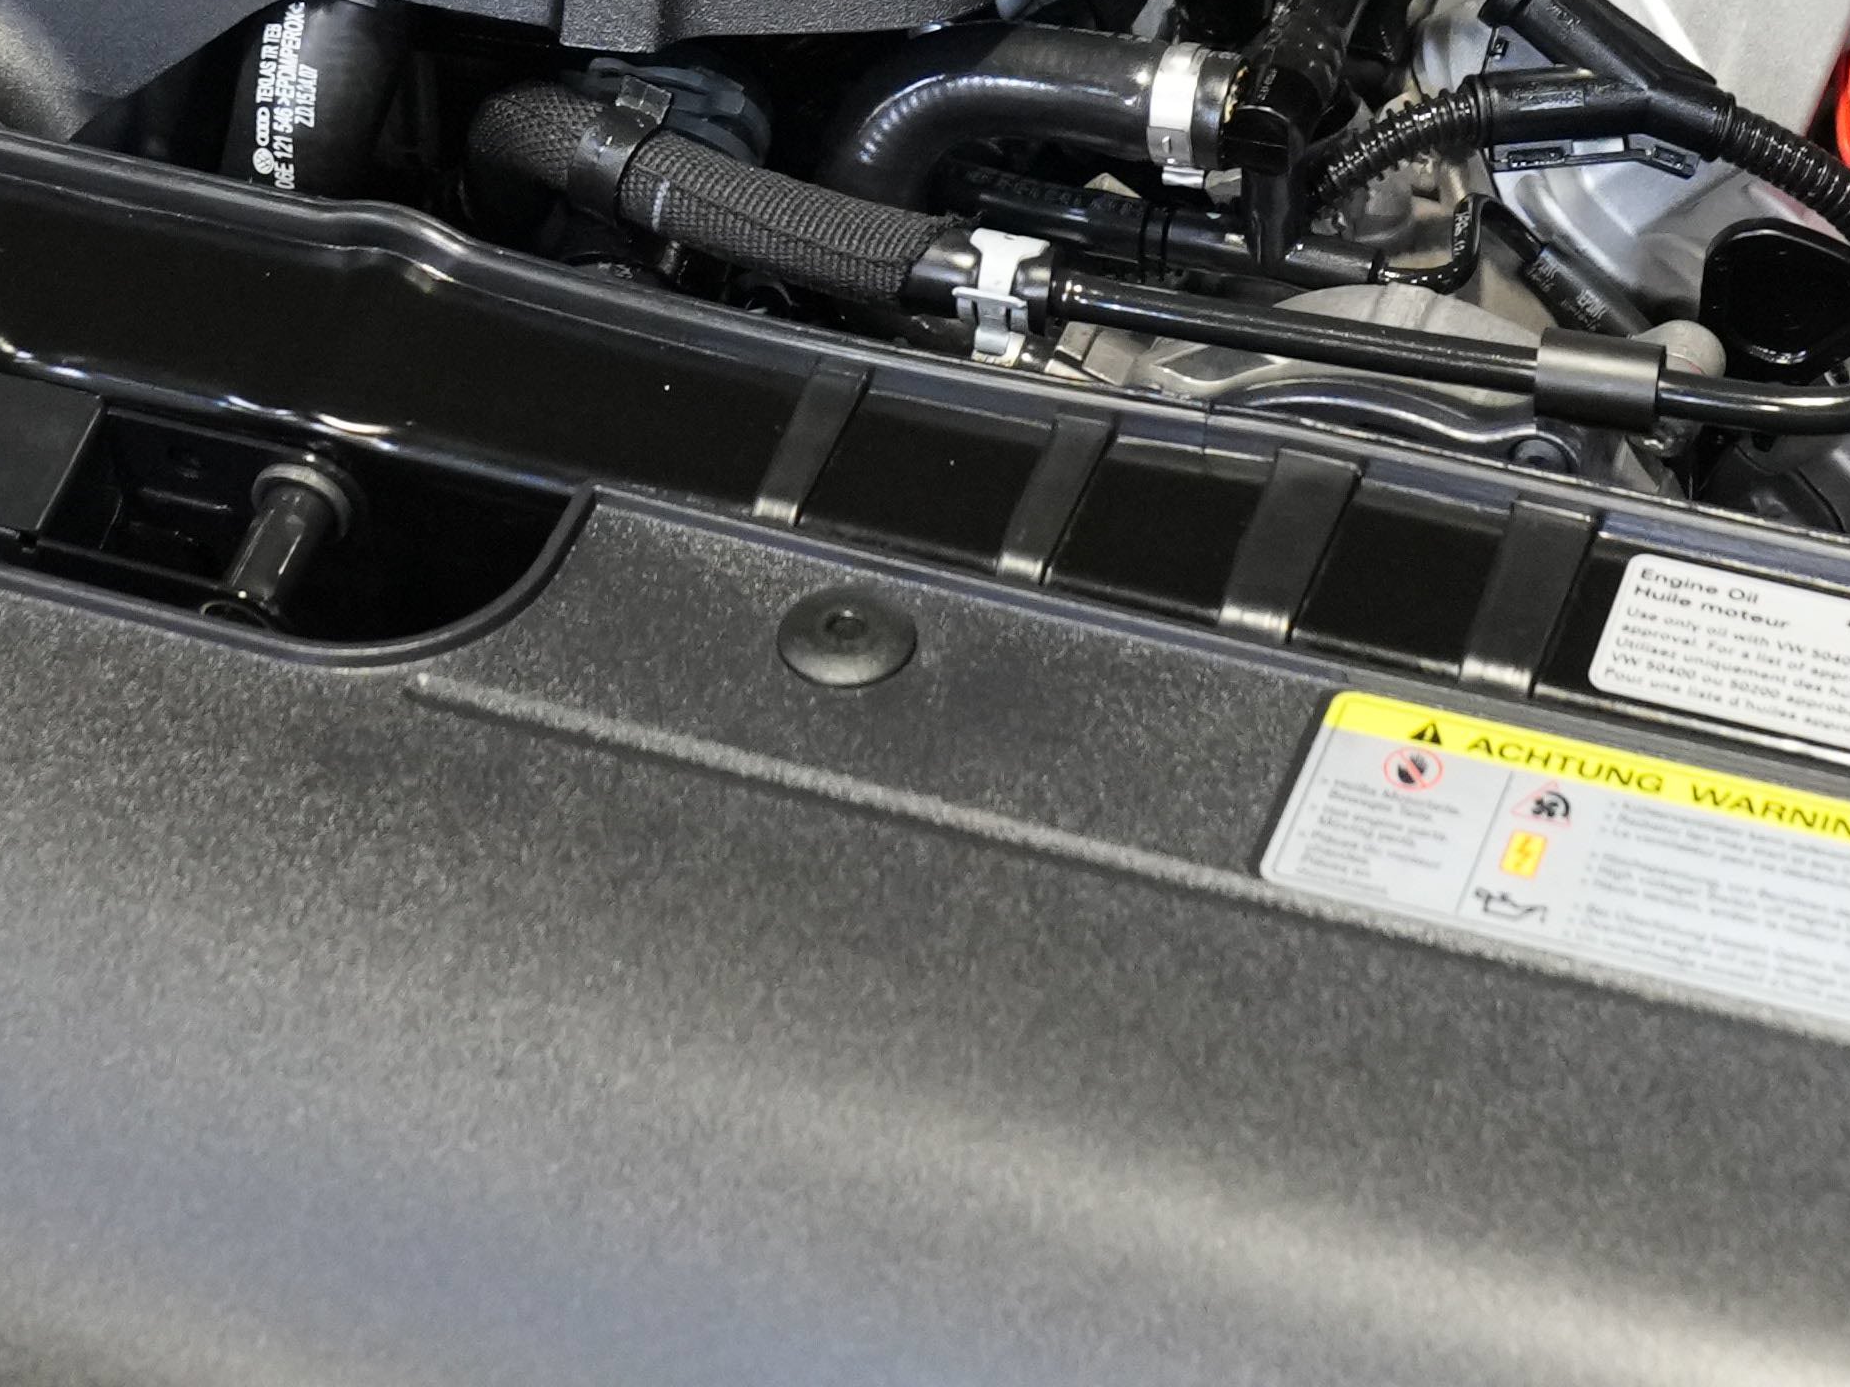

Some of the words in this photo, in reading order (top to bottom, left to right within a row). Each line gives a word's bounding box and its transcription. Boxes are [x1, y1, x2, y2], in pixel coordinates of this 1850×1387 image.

[272, 134, 294, 160] 121
[274, 160, 296, 190] 06E
[1640, 566, 1719, 596] Engine
[1727, 586, 1760, 606] Oil
[1632, 584, 1692, 609] Huile
[1700, 600, 1792, 630] moteur
[1662, 612, 1700, 633] only
[1733, 628, 1770, 648] with
[1466, 734, 1663, 794] ACHTUNG
